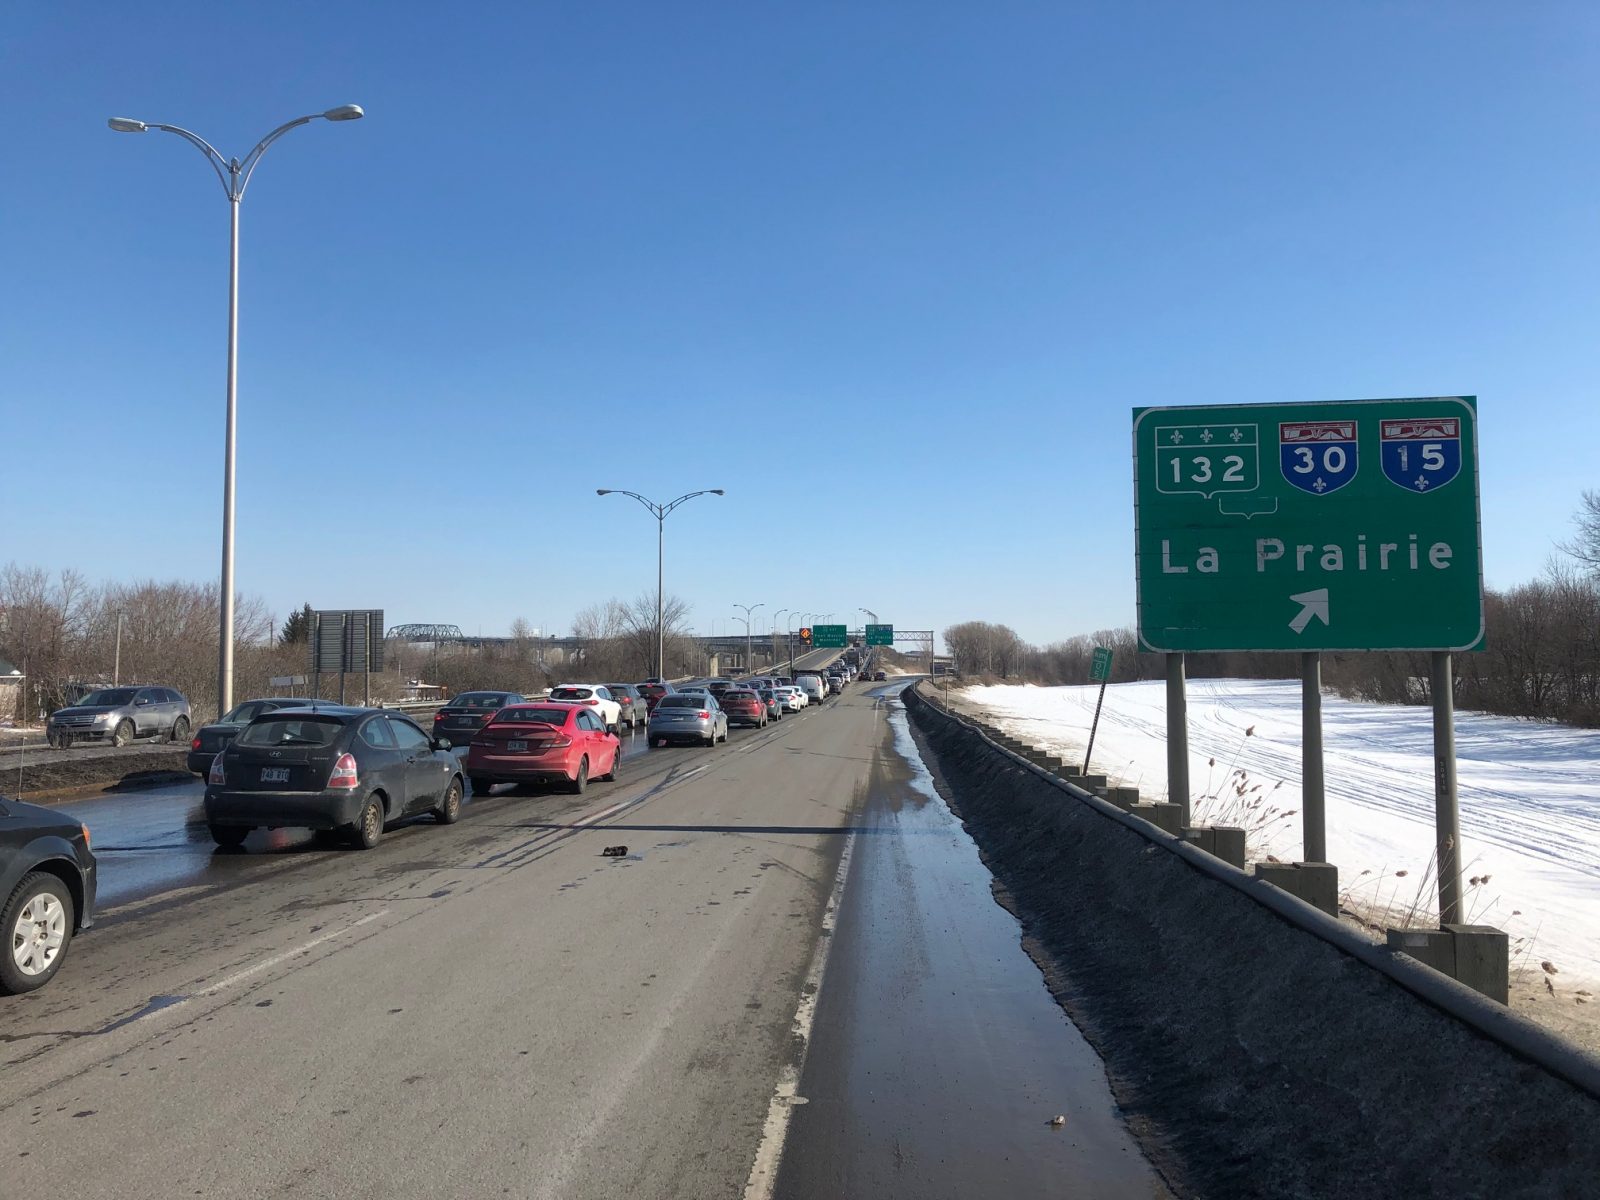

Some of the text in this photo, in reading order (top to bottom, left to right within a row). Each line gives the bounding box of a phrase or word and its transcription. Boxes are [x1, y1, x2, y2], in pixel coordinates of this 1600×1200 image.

[1169, 455, 1245, 483] 132
[1292, 446, 1347, 474] 30
[1397, 443, 1445, 472] 15
[1161, 534, 1453, 574] La Prairie
[1094, 650, 1106, 660] km
